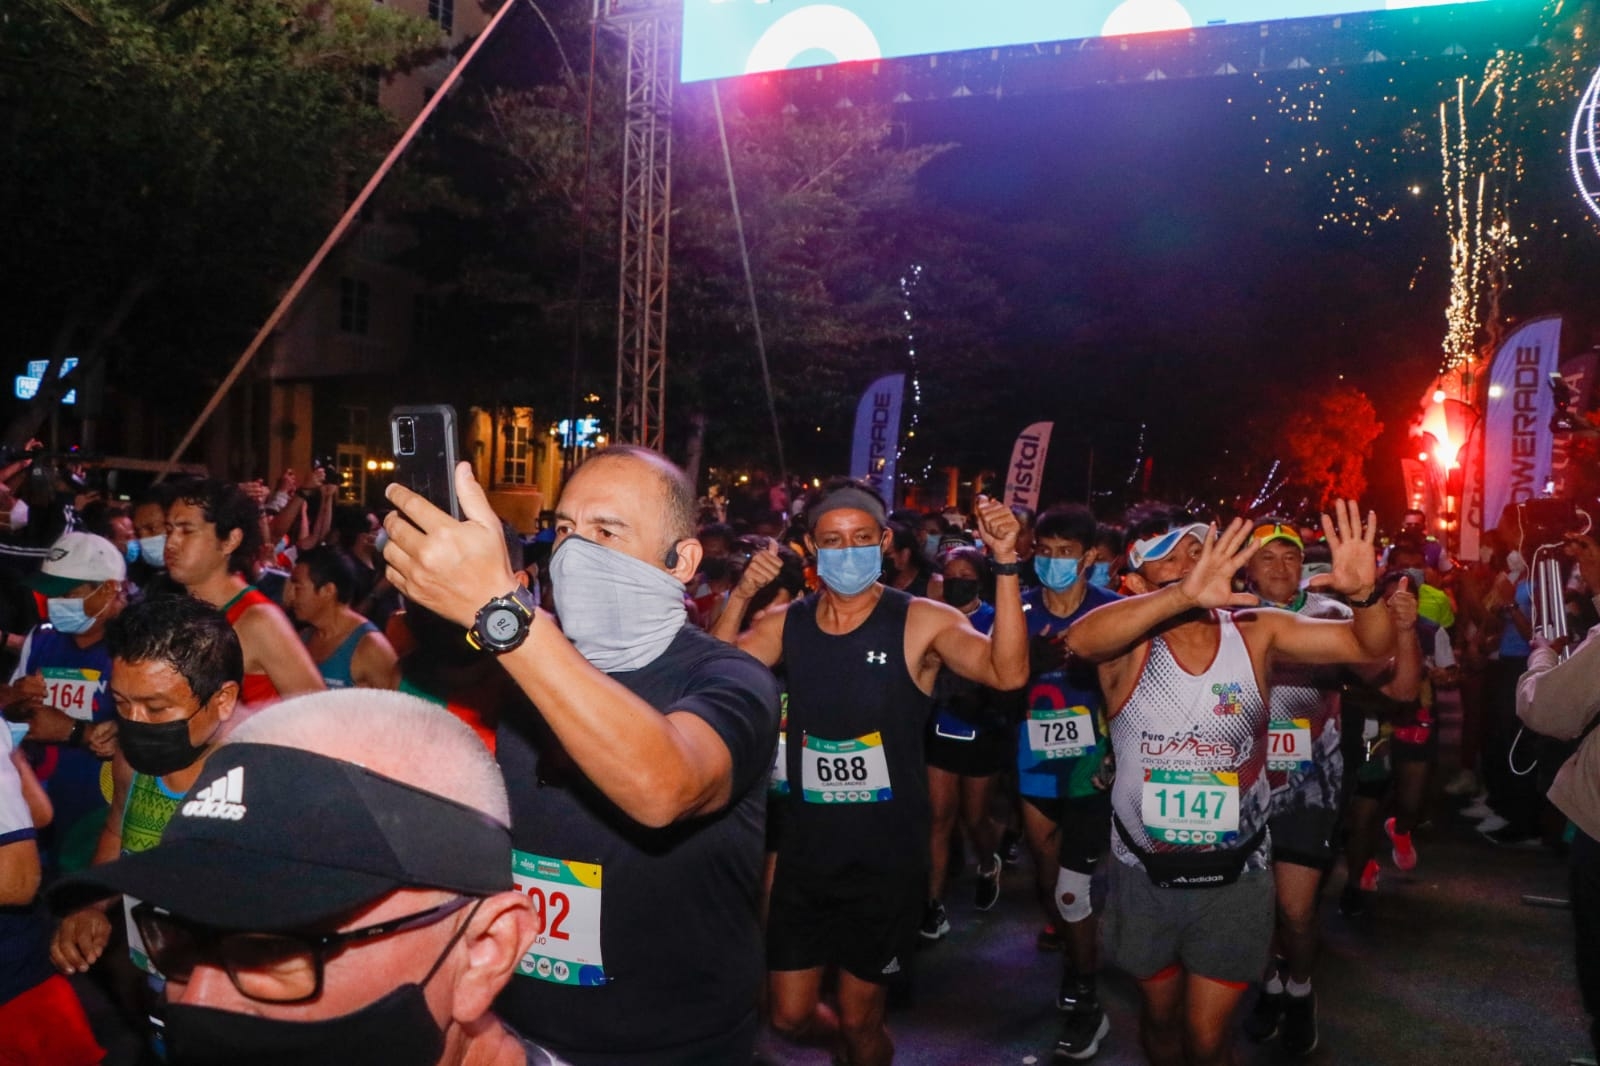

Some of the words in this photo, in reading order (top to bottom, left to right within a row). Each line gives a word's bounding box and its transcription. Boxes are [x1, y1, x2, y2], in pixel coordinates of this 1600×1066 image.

[1510, 346, 1541, 503] OWERADE
[1007, 433, 1040, 505] ristal
[1039, 721, 1079, 743] 728
[1141, 731, 1165, 742] Puro
[1268, 733, 1295, 753] 70
[817, 756, 868, 782] 688
[1154, 789, 1228, 819] 1147
[1188, 874, 1224, 884] adidas
[513, 882, 570, 941] 92
